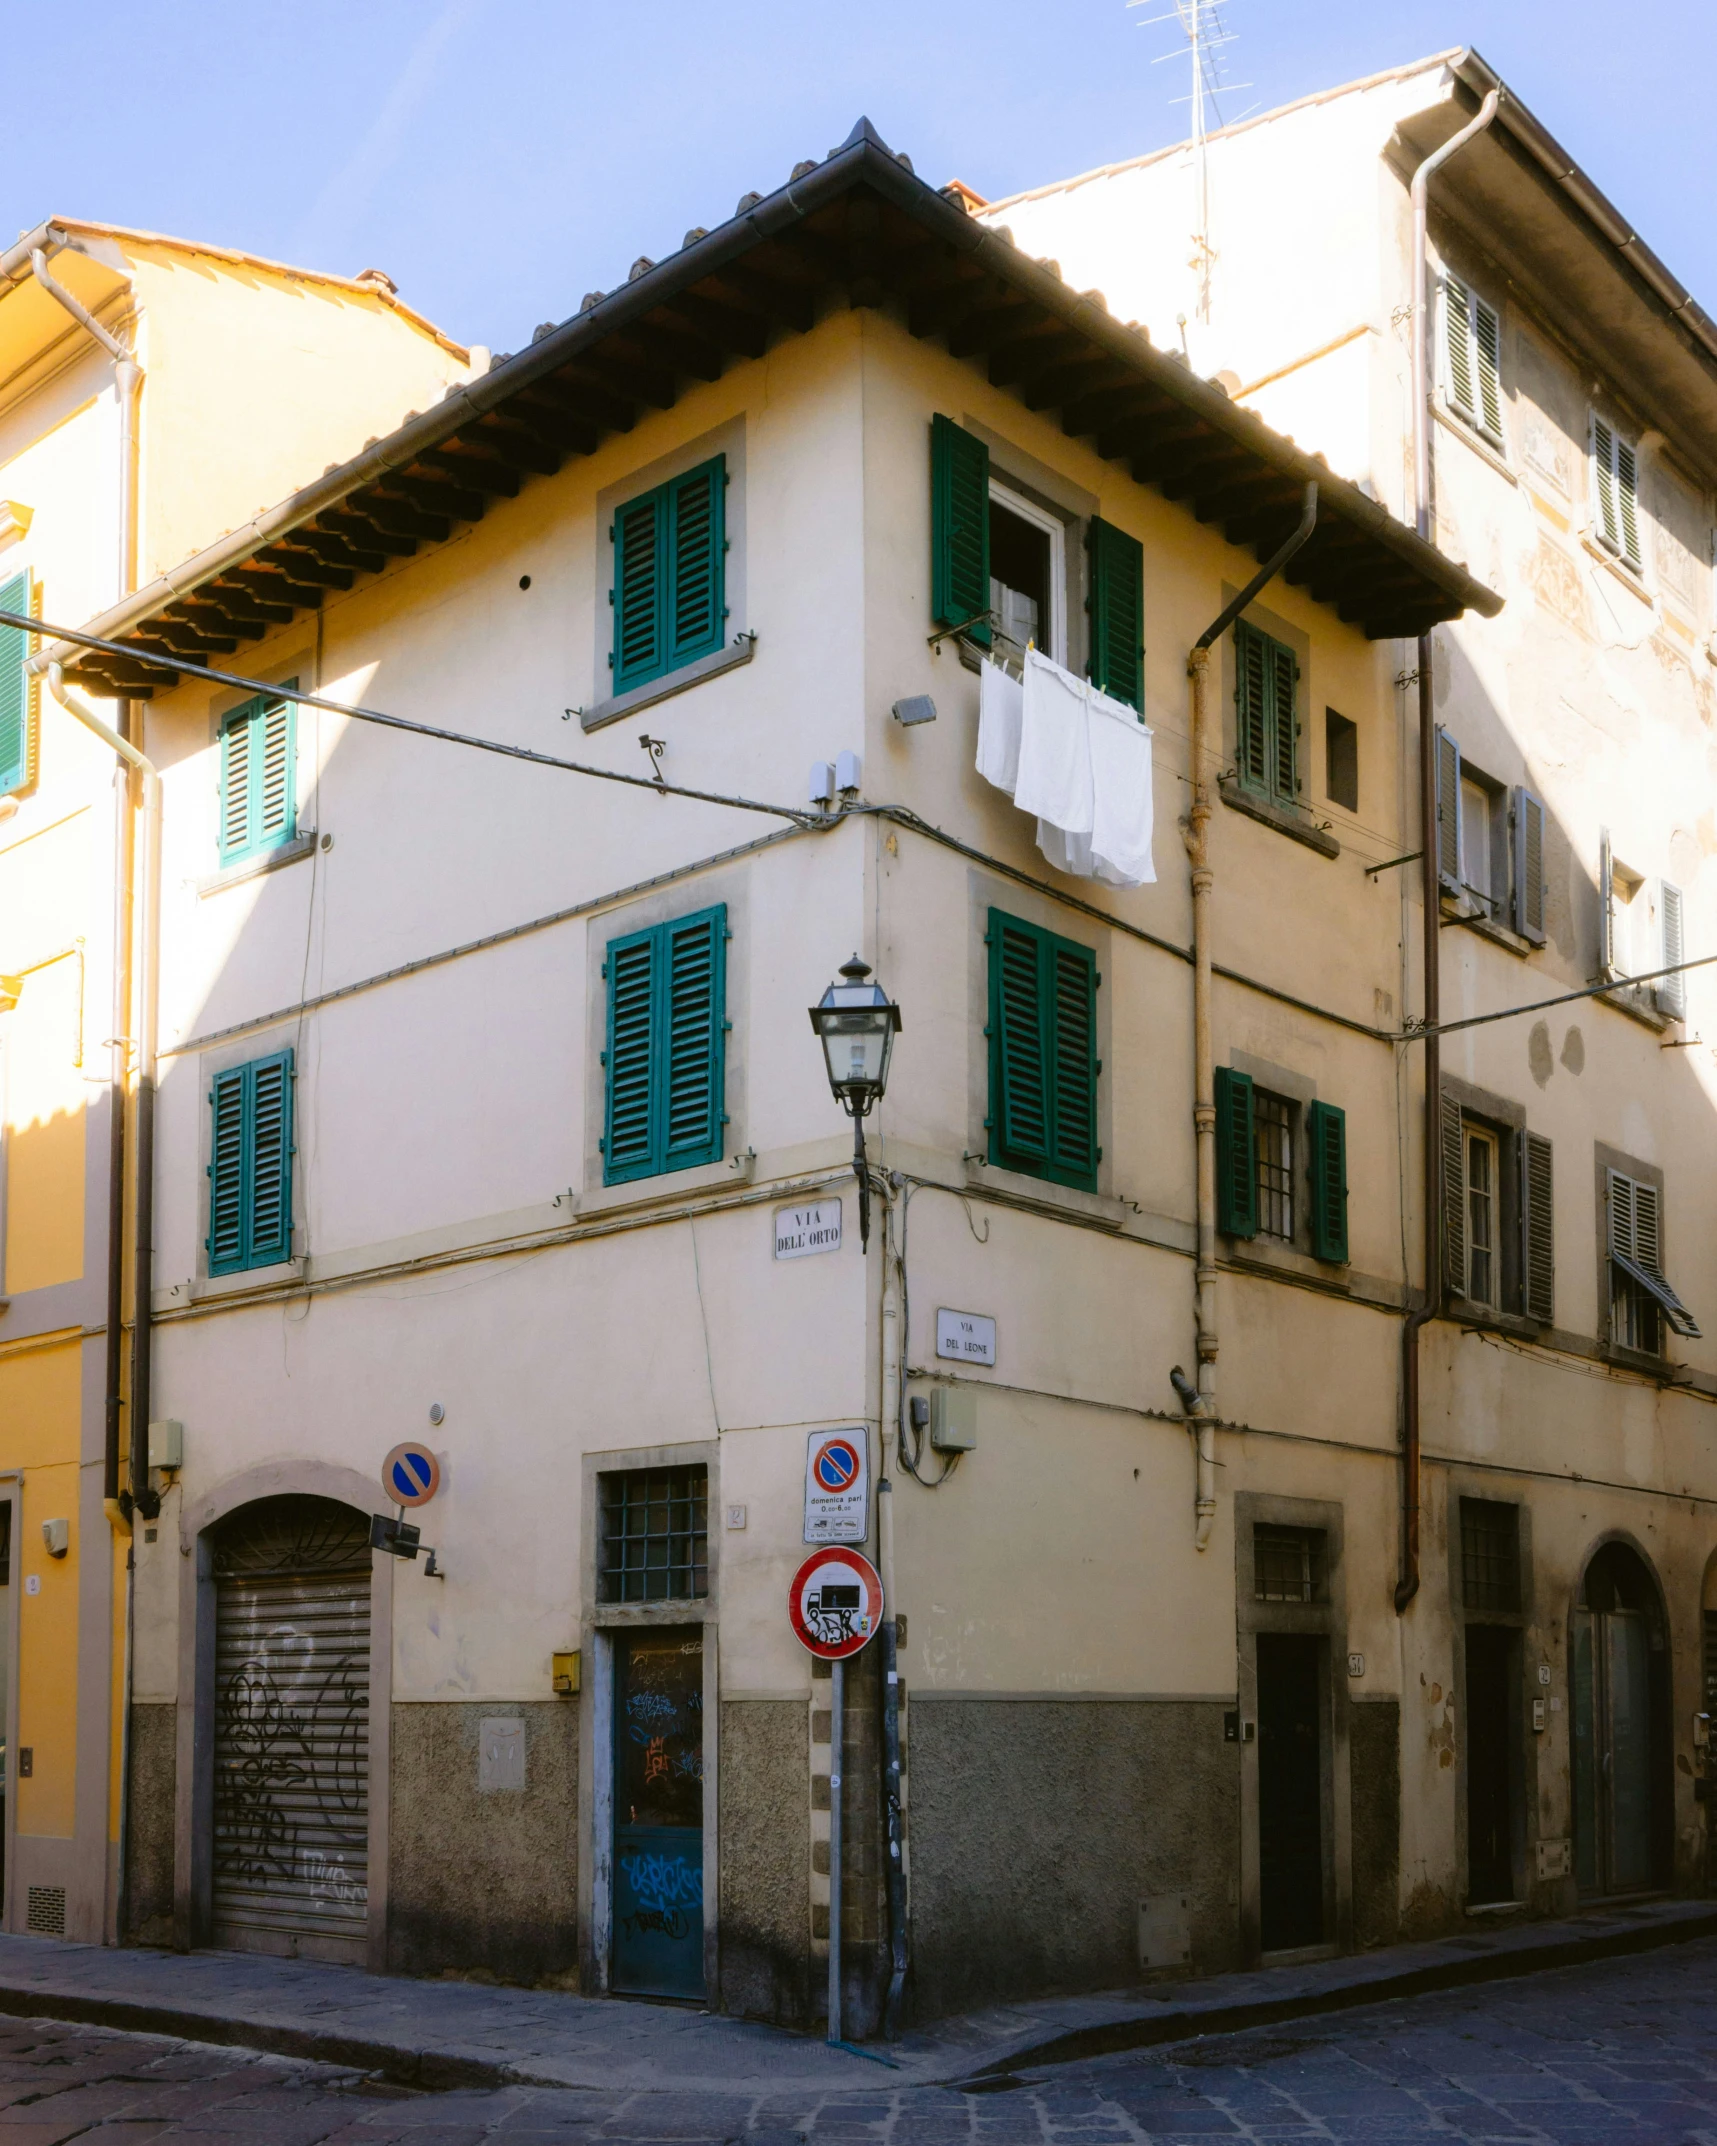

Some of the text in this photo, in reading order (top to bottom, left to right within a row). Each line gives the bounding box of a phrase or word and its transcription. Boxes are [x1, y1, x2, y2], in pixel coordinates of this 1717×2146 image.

[795, 1210, 821, 1227] VIA
[777, 1227, 839, 1252] DELL' ORTO
[960, 1321, 974, 1333] VIA
[946, 1338, 988, 1355] DEL LEONE
[810, 1494, 862, 1505] domenica pari
